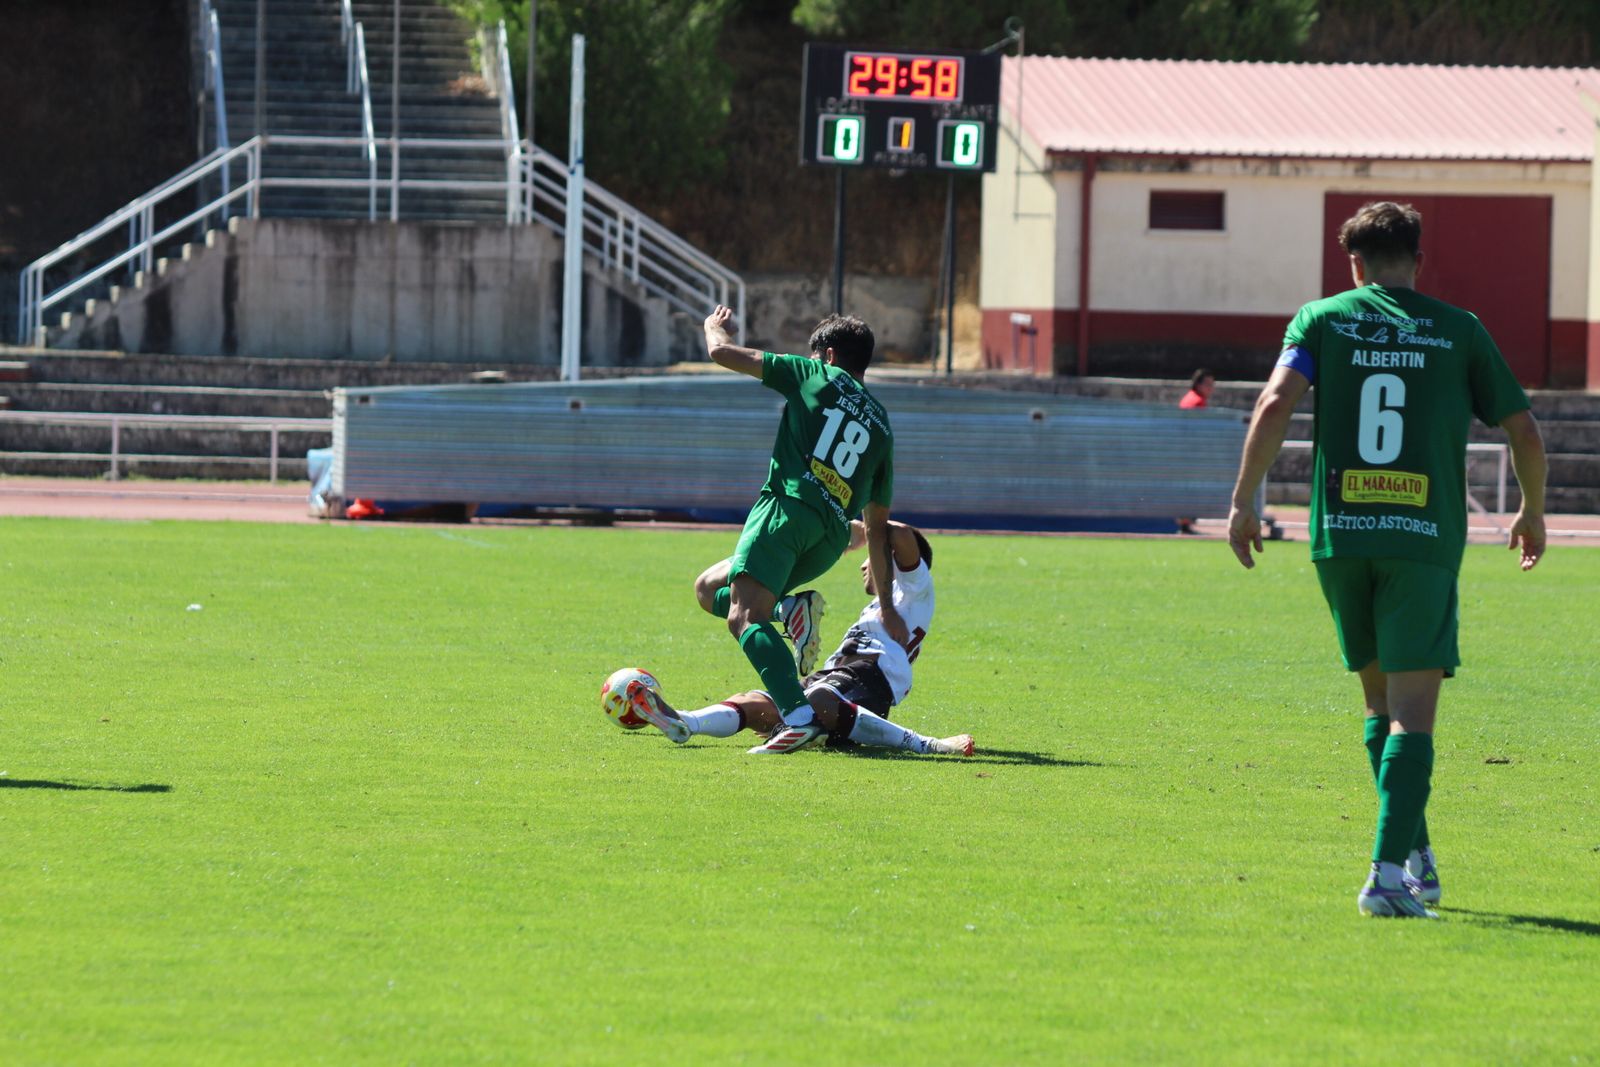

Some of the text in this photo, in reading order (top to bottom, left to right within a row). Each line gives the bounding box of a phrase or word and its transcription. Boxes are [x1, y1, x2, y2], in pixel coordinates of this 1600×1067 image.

[849, 55, 959, 100] 29:58
[834, 118, 860, 160] 0
[901, 121, 911, 149] 1
[953, 123, 979, 166] 0
[1351, 311, 1433, 327] RESTAURANTE
[1366, 326, 1389, 343] La
[1352, 350, 1425, 369] ALBERTIN
[1358, 373, 1406, 465] 6
[813, 407, 870, 479] 18
[1348, 475, 1422, 495] EL MARAGATO
[1377, 515, 1439, 538] ASTORGA
